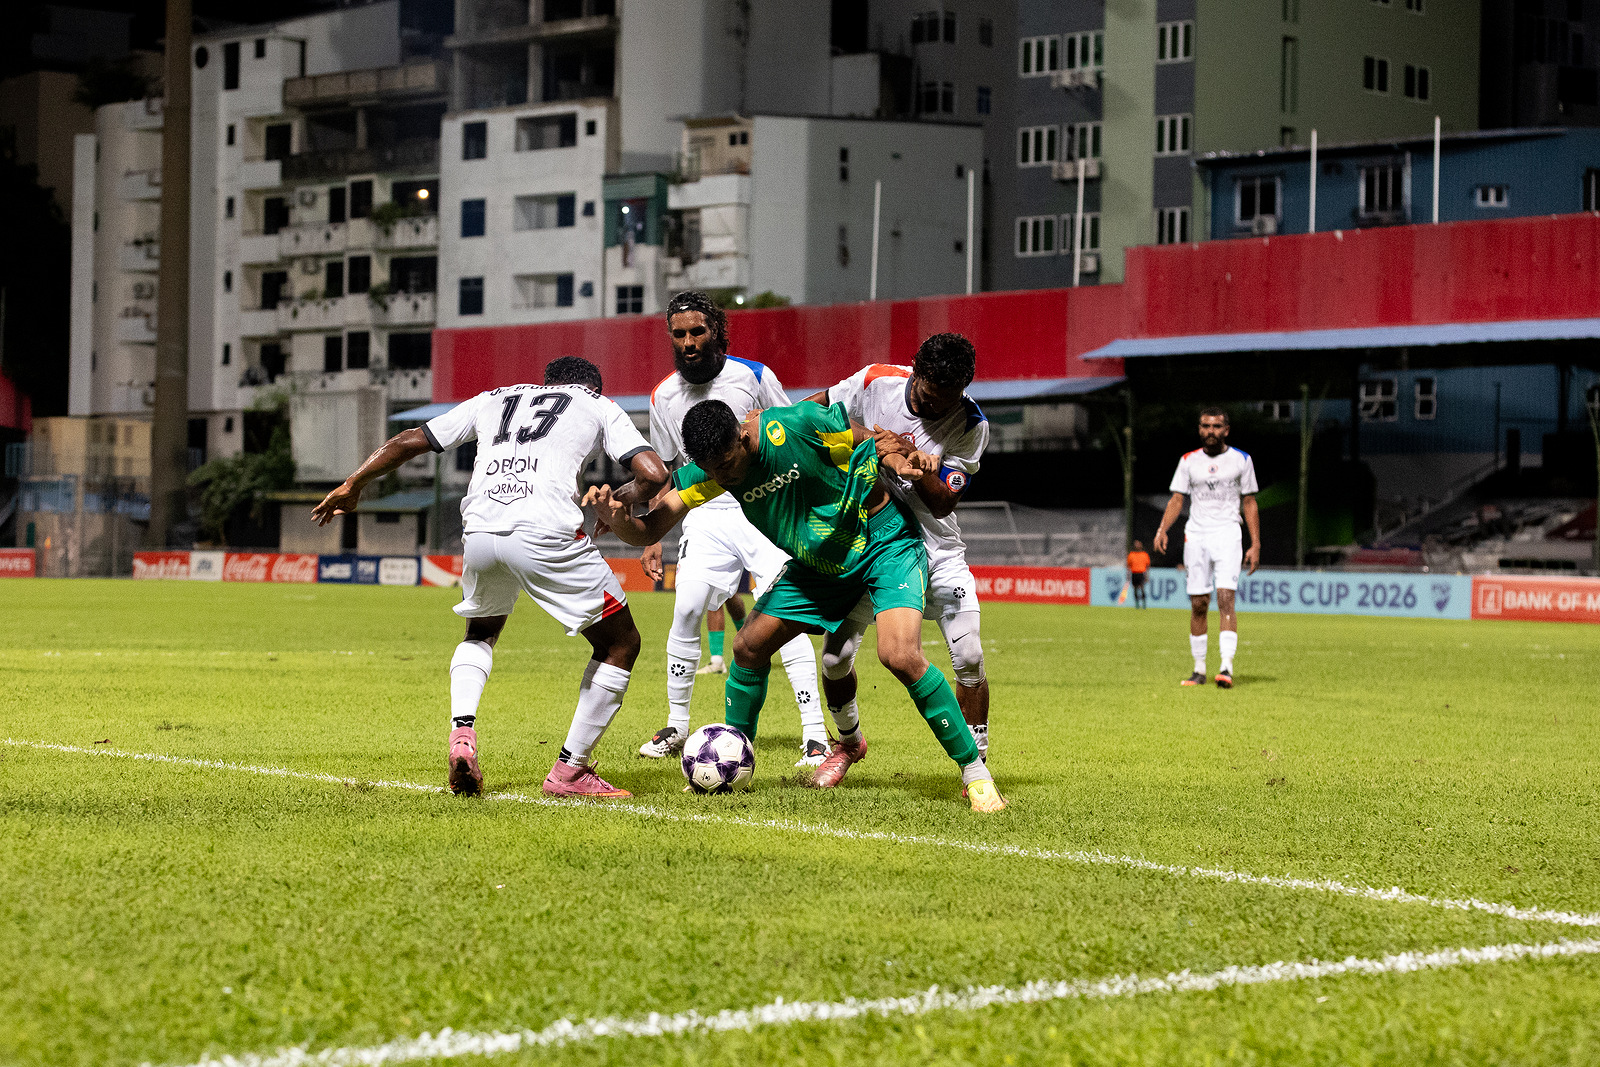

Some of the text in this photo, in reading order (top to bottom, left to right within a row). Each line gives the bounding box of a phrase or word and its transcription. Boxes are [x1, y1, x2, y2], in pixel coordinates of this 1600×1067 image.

[492, 392, 573, 446] 13
[743, 468, 800, 503] ooredoo
[994, 578, 1013, 595] OF
[1015, 579, 1086, 598] MALDIVES
[1149, 579, 1178, 601] UP
[1300, 581, 1350, 608] CUP
[1357, 583, 1418, 609] 2026
[1504, 590, 1552, 611] BANK
[1557, 591, 1581, 612] OF
[726, 696, 732, 707] 9
[941, 718, 949, 728] 9
